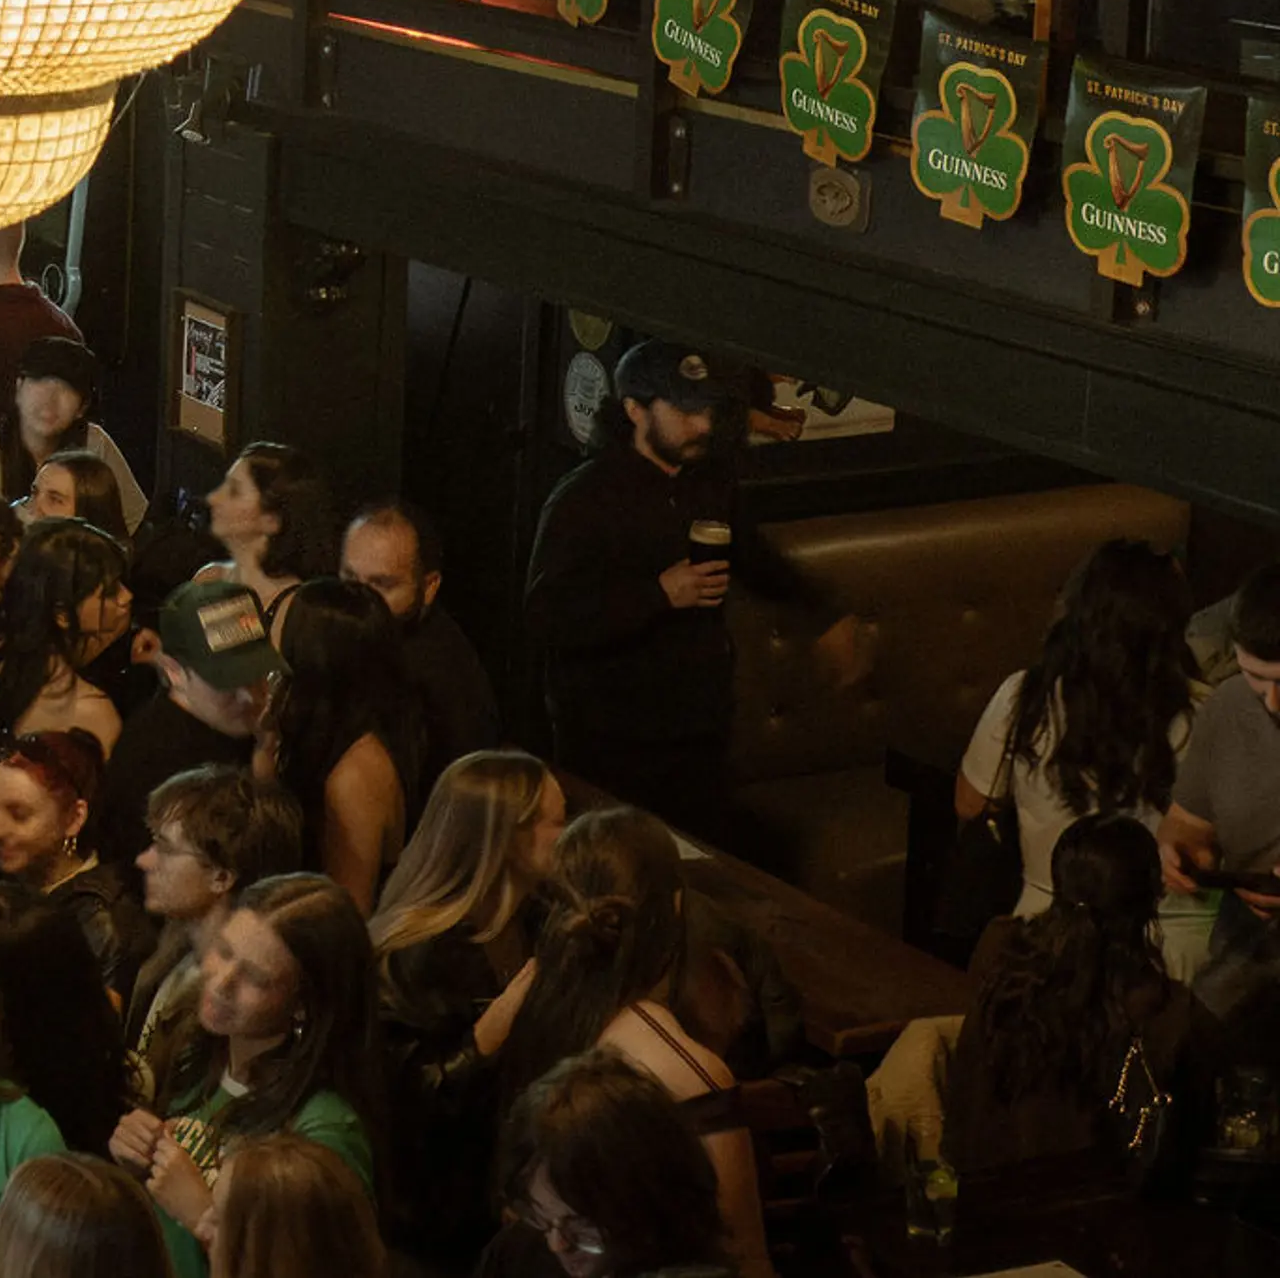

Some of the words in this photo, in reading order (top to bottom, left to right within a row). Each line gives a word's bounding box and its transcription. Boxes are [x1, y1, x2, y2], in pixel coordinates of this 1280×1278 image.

[858, 1, 881, 20] DAY
[664, 18, 724, 69] GUINNESS
[956, 37, 1006, 63] PATRICK'S
[1007, 50, 1028, 68] DAY
[791, 87, 858, 134] GUINNESS
[1104, 83, 1161, 111] PATRICK'S
[1162, 95, 1186, 115] DAY
[927, 147, 1008, 191] GUINNESS
[1080, 201, 1168, 246] GUINNESS
